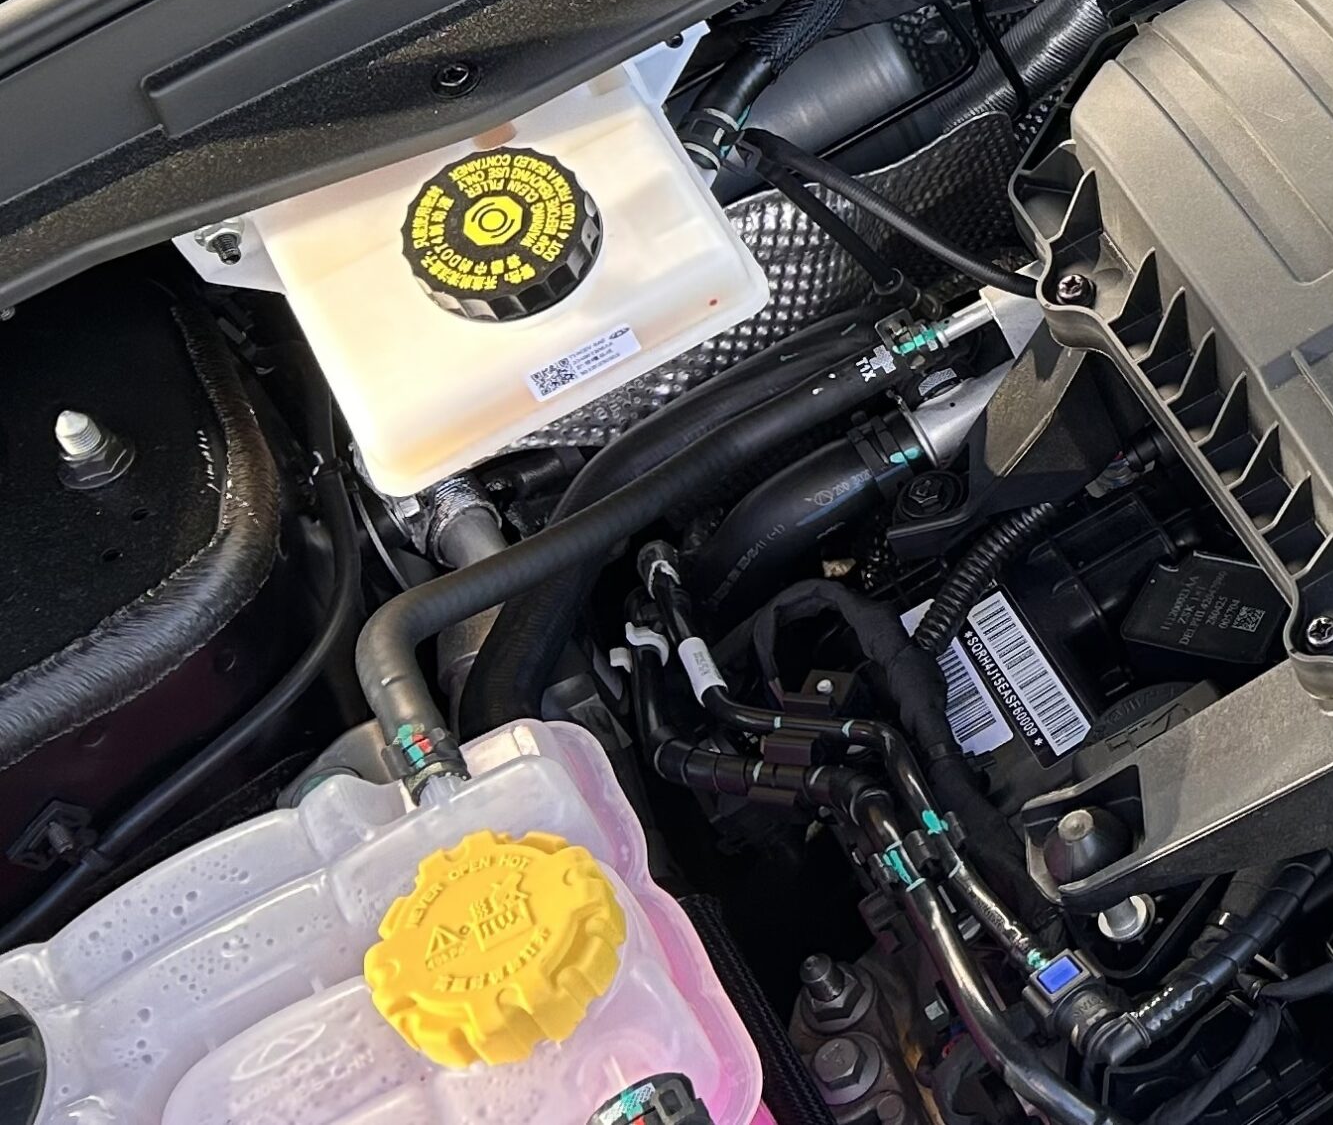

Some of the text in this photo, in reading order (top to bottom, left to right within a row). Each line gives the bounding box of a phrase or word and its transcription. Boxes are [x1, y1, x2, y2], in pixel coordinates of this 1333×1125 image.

[447, 153, 511, 182] CONTAINER
[513, 154, 551, 176] SEALED
[553, 174, 573, 201] FROM
[456, 165, 560, 255] CAP BEFORE REMOVING USE ONLY
[462, 178, 545, 250] WARNING CLEAN FILLER
[560, 202, 575, 230] FLUID
[559, 231, 569, 239] 4
[542, 238, 563, 262] DOT
[853, 355, 877, 382] T1X
[406, 853, 531, 929] NEVER OPEN HOT
